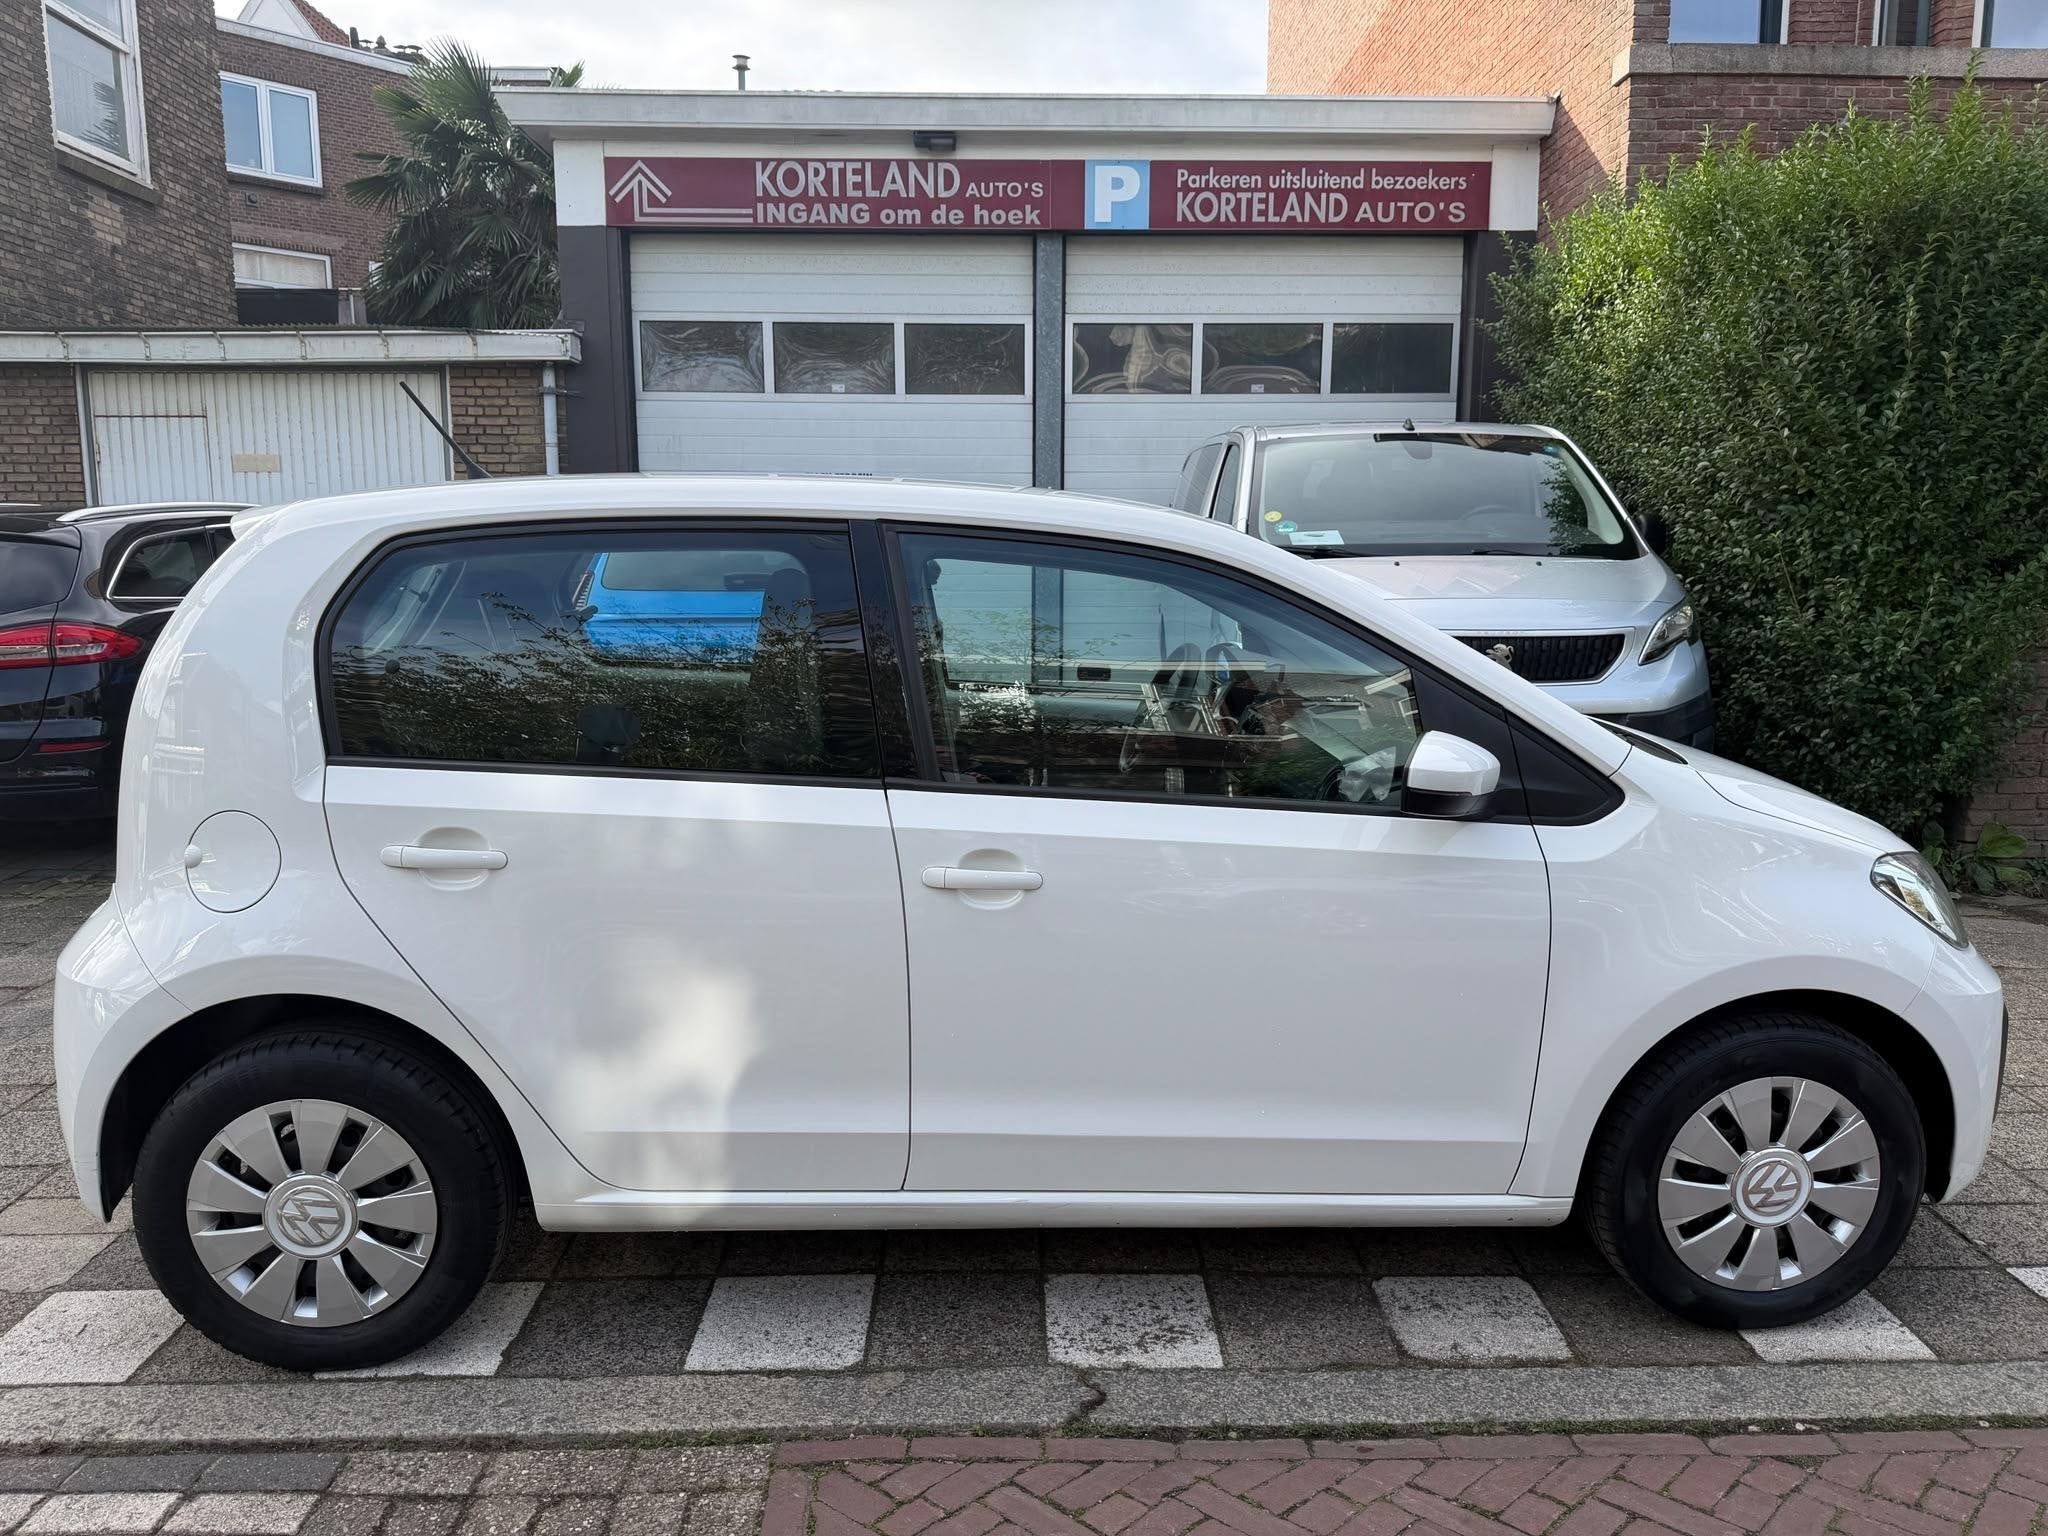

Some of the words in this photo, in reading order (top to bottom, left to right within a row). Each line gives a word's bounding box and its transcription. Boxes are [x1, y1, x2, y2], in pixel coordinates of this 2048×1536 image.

[755, 160, 960, 198] KORTELAND
[965, 182, 1044, 198] AUTO'S
[1094, 165, 1140, 223] P
[1176, 166, 1262, 189] Parkeren
[1268, 167, 1364, 189] uitsluitend
[1371, 167, 1467, 190] bezoekers
[756, 202, 870, 224] INGANG
[880, 208, 921, 225] om
[931, 204, 964, 225] de
[974, 204, 1041, 225] hoek
[1176, 191, 1348, 223] KORTELAND
[1354, 201, 1466, 223] AUTO'S
